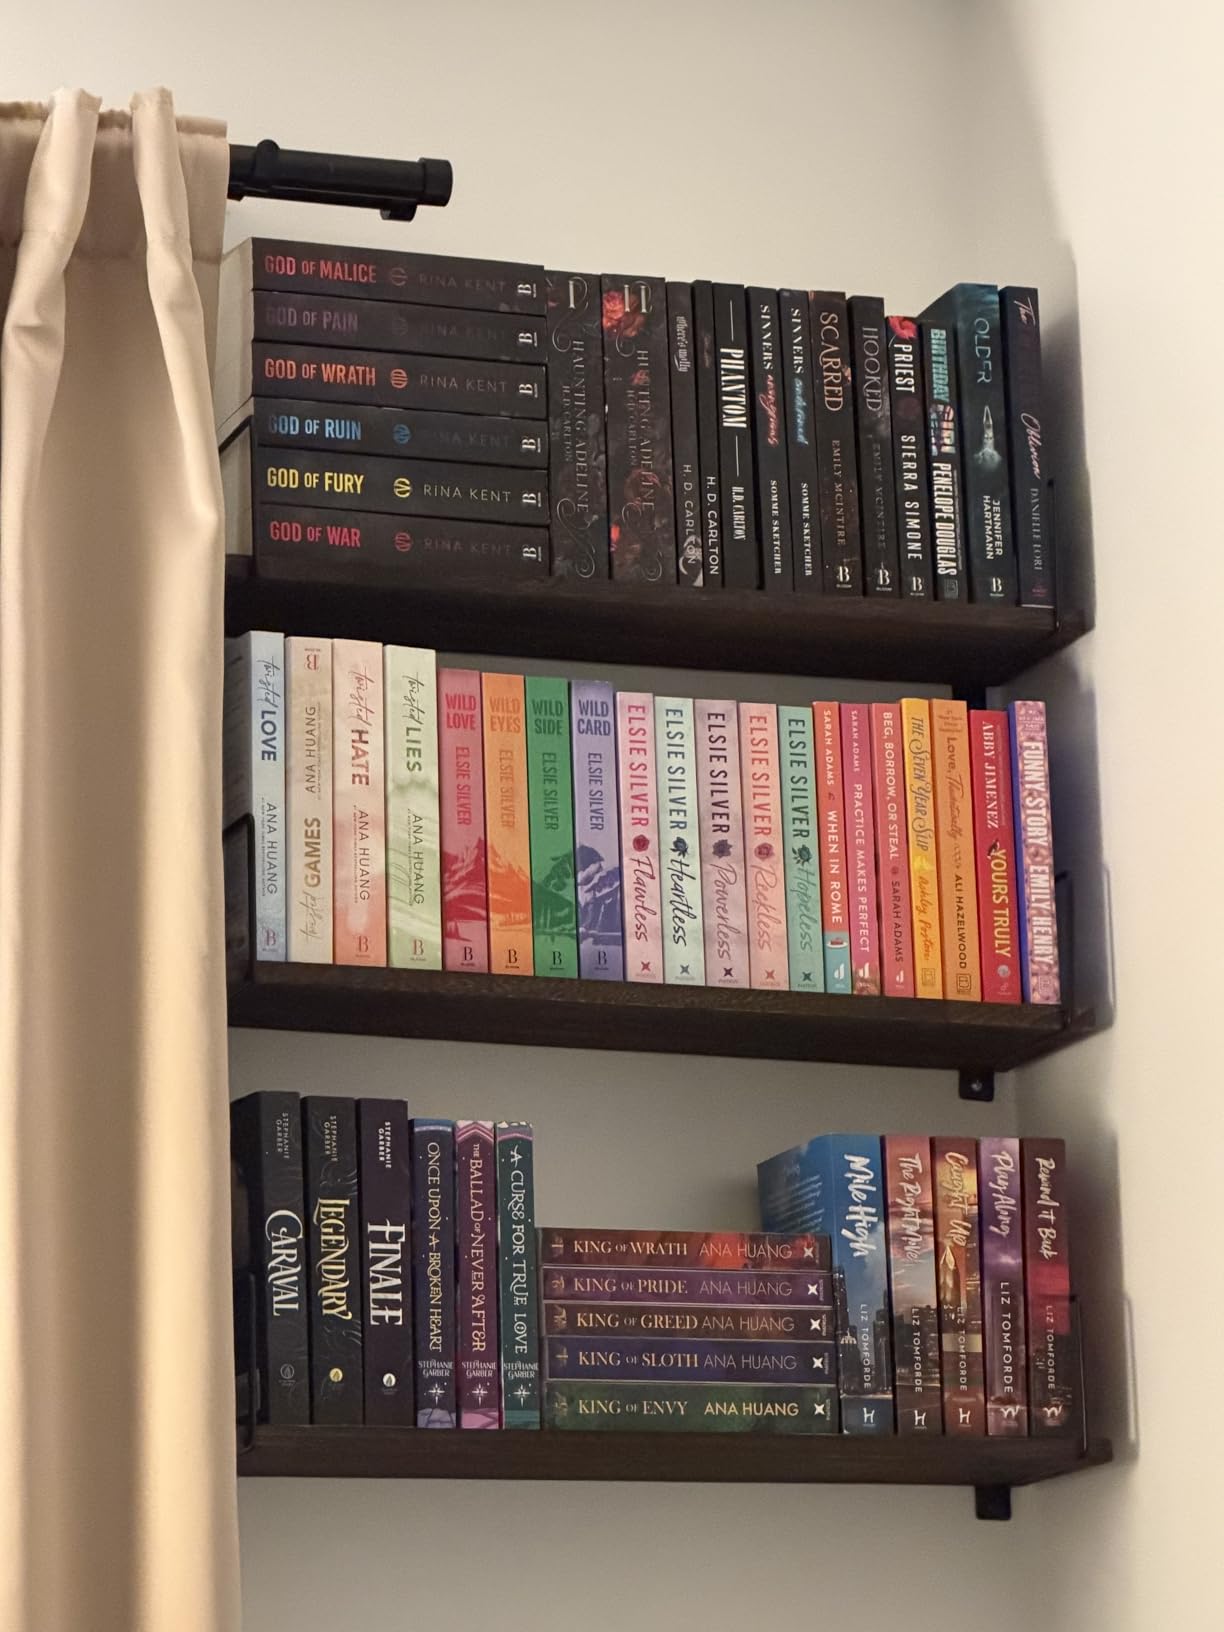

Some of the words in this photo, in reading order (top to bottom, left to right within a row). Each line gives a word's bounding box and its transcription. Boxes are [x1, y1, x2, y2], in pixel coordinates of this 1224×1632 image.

[264, 255, 296, 276] GOD
[302, 260, 316, 275] OF
[320, 260, 376, 284] MALICE
[302, 311, 317, 326] OF
[323, 311, 358, 332] PAIN
[760, 304, 774, 370] SINNERS
[791, 308, 804, 374] SINNERS
[264, 358, 296, 380] GOD
[302, 364, 316, 380] OF
[322, 363, 376, 386] WRATH
[420, 374, 458, 388] RINA
[466, 378, 506, 392] KENT
[819, 312, 844, 412] SCARRED
[862, 327, 882, 412] HOOKED
[894, 344, 915, 394] PRIEST
[930, 328, 950, 403] BIRTHDAY
[572, 340, 586, 431] HAUNTING
[720, 348, 748, 428] PHANTOM
[269, 415, 300, 434] GOD
[304, 419, 320, 434] OF
[324, 419, 362, 441] RUIN
[267, 467, 299, 488] GOD
[304, 472, 320, 488] OF
[324, 472, 364, 494] FURY
[575, 438, 588, 512] ADELINE
[901, 434, 918, 491] SIERRA
[424, 484, 462, 498] RINA
[470, 488, 512, 504] KENT
[932, 462, 954, 520] PENELOPE
[270, 521, 301, 542] GOD
[307, 526, 322, 542] OF
[326, 525, 360, 548] WAR
[708, 510, 719, 575] CARLTON
[904, 502, 922, 560] SIMONE
[936, 522, 958, 576] DOUGLAS
[983, 495, 994, 560] HARTMANN
[992, 500, 1003, 556] JENNIFER
[445, 692, 476, 710] WILD
[446, 713, 476, 730] LOVE
[489, 696, 520, 714] WILD
[532, 700, 564, 717] WILD
[578, 699, 608, 717] WILD
[261, 710, 276, 762] LOVE
[306, 706, 316, 758] HUANG
[490, 715, 521, 734] EYES
[534, 718, 562, 736] SIDE
[578, 718, 611, 736] CARD
[628, 704, 646, 756] ELSIE
[666, 708, 685, 759] ELSIE
[708, 712, 728, 764] ELSIE
[749, 715, 769, 766] ELSIE
[788, 718, 807, 768] ELSIE
[824, 710, 833, 745] SARAH
[912, 717, 924, 738] THE
[982, 720, 996, 758] ABBY
[352, 728, 370, 786] HATE
[406, 726, 422, 772] LIES
[456, 746, 470, 780] ELSIE
[498, 750, 514, 784] ELSIE
[542, 752, 558, 785] ELSIE
[588, 752, 602, 784] ELSIE
[826, 748, 834, 785] ADAMS
[884, 742, 896, 800] BORROW,
[1022, 742, 1046, 792] FUNNY
[305, 764, 316, 794] ANA
[629, 762, 649, 827] SILVER
[668, 766, 687, 830] SILVER
[710, 770, 730, 834] SILVER
[984, 762, 999, 829] JIMENEZ
[267, 802, 277, 834] ANA
[358, 809, 369, 841] ANA
[456, 783, 472, 826] SILVER
[500, 786, 516, 828] SILVER
[544, 788, 559, 831] SILVER
[589, 788, 604, 831] SILVER
[752, 772, 772, 836] SILVER
[790, 776, 810, 838] SILVER
[854, 784, 864, 846] PRACTICE
[888, 803, 897, 821] OR
[1025, 796, 1048, 849] STORY
[304, 816, 321, 888] GAMES
[412, 814, 423, 845] ANA
[827, 810, 838, 854] WHEN
[889, 824, 899, 860] STEAL
[267, 840, 278, 895] HUANG
[359, 847, 370, 900] HUANG
[413, 851, 424, 904] HUANG
[830, 859, 840, 874] IN
[856, 850, 866, 892] MAKES
[954, 874, 962, 892] ALI
[990, 849, 1008, 904] YOURS
[1029, 864, 1052, 910] EMILY
[629, 856, 657, 943] Flawless
[667, 858, 696, 946] Heartless
[710, 862, 741, 960] Powerless
[750, 864, 782, 952] Reckless
[830, 881, 842, 924] ROME
[892, 881, 902, 916] SARAH
[858, 896, 870, 952] PERFECT
[894, 922, 904, 962] ADAMS
[956, 896, 967, 969] HAZELWOOD
[993, 908, 1011, 958] TRULY
[1032, 916, 1054, 964] HENRY
[428, 1142, 440, 1184] ONCE
[510, 1145, 523, 1168] A
[844, 1153, 876, 1204] Mile
[898, 1152, 922, 1180] The
[428, 1188, 441, 1230] UPON
[470, 1159, 484, 1222] BALLAD
[508, 1170, 526, 1220] CURSE
[428, 1232, 440, 1252] A
[512, 1224, 525, 1256] FOR
[574, 1240, 612, 1254] KING
[629, 1242, 688, 1256] WRATH
[700, 1243, 732, 1256] ANA
[738, 1244, 792, 1259] HUANG
[840, 1202, 880, 1258] High
[265, 1209, 304, 1316] CARAVAL
[313, 1198, 352, 1320] LEGENDARY
[367, 1218, 406, 1326] FINALE
[428, 1252, 442, 1305] BROKEN
[471, 1233, 486, 1292] NEVER
[510, 1259, 528, 1306] TRUE
[574, 1278, 616, 1292] KING
[638, 1278, 688, 1294] PRIDE
[700, 1281, 732, 1295] ANA
[738, 1281, 792, 1296] HUANG
[1000, 1282, 1011, 1305] LIZ
[430, 1308, 442, 1352] HEART
[472, 1294, 486, 1352] AFTER
[514, 1313, 528, 1354] LOVE
[576, 1313, 620, 1328] KING
[640, 1314, 698, 1330] GREED
[702, 1316, 734, 1330] ANA
[740, 1316, 794, 1332] HUANG
[860, 1304, 868, 1322] LIZ
[912, 1308, 920, 1326] LIZ
[578, 1351, 621, 1366] KING
[641, 1352, 698, 1368] SLOTH
[704, 1354, 736, 1368] ANA
[741, 1355, 797, 1370] HUANG
[861, 1327, 872, 1389] TOMFORDE
[913, 1332, 922, 1393] TOMFORDE
[958, 1330, 968, 1391] TOMFORDE
[1002, 1312, 1014, 1393] TOMFORDE
[1046, 1329, 1056, 1390] TOMFORDE
[578, 1399, 621, 1414] KING
[642, 1400, 688, 1416] ENVY
[704, 1402, 738, 1416] ANA
[742, 1402, 800, 1417] HUANG
